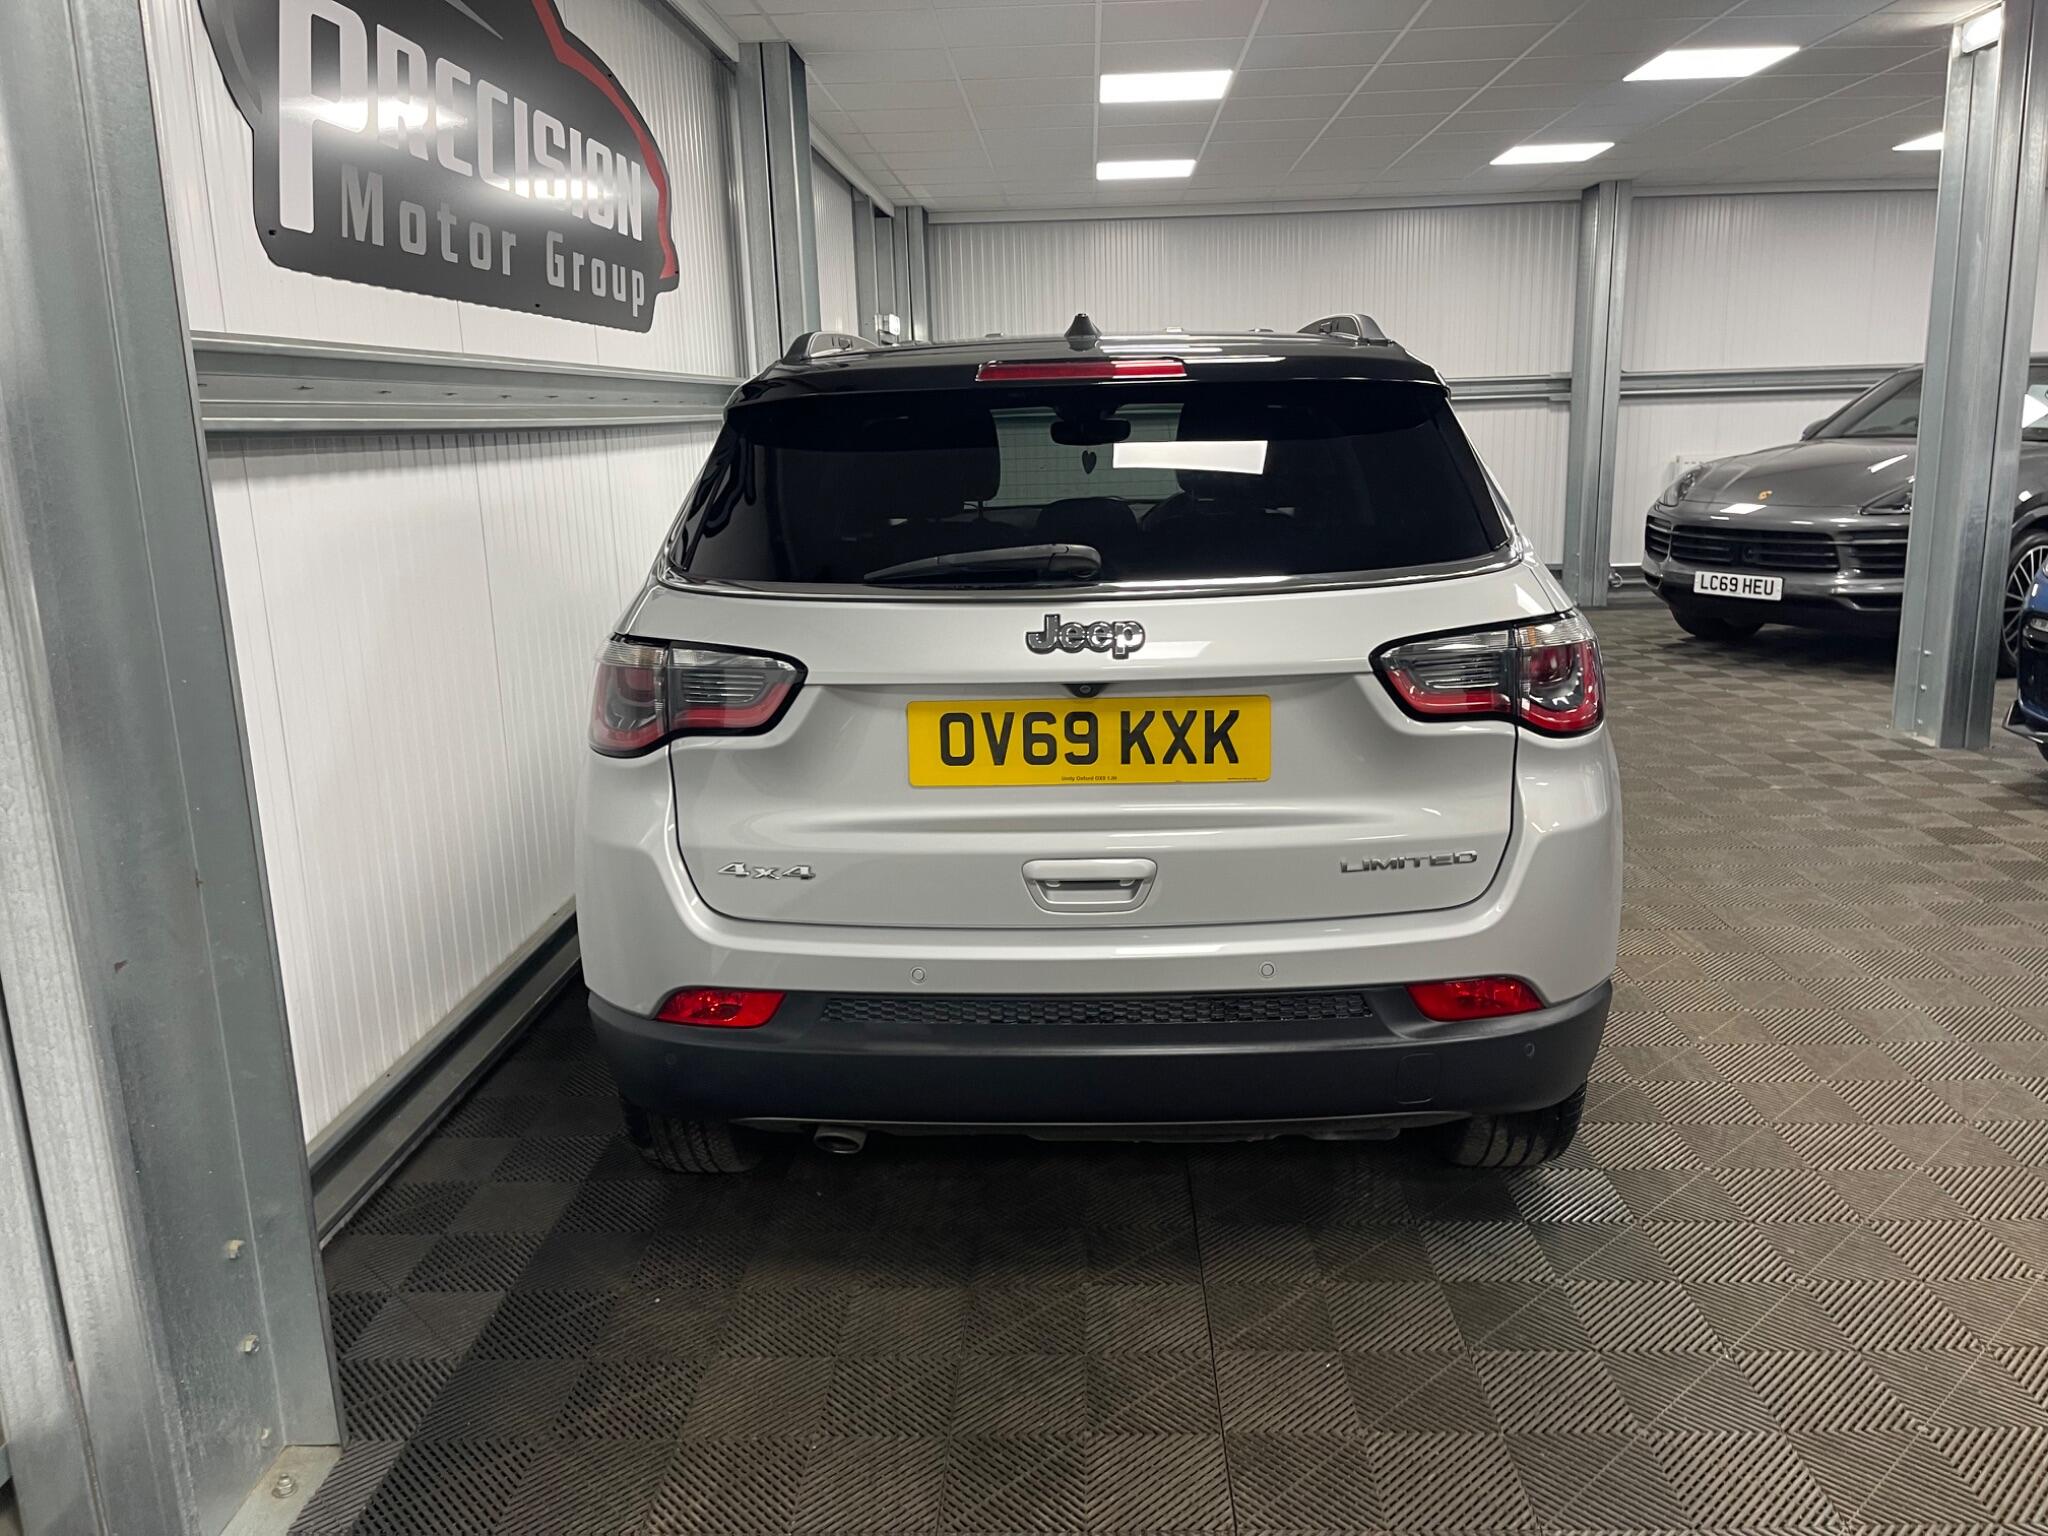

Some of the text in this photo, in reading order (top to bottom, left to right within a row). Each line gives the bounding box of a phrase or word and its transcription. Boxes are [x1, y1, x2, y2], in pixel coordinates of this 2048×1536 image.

[279, 0, 642, 241] PRECISION
[341, 162, 645, 317] Motor Group
[1700, 574, 1775, 596] LC69 HEU
[1025, 614, 1145, 659] Jeep
[939, 710, 1240, 766] OV69 KXK
[717, 862, 816, 880] 4x4
[1340, 850, 1478, 873] LIMITED
